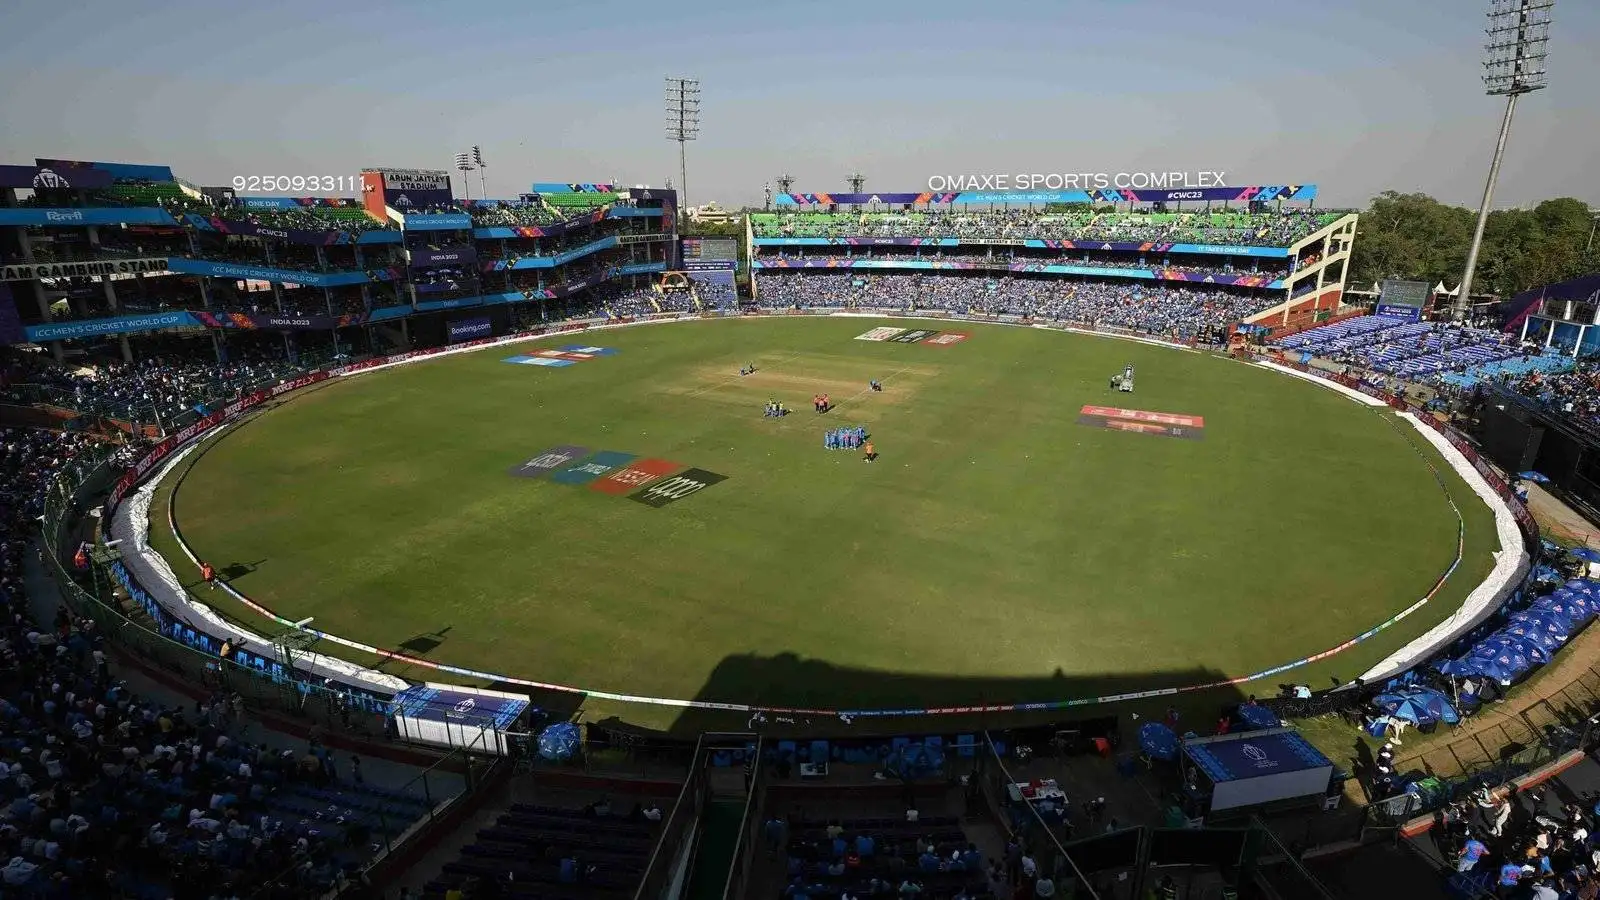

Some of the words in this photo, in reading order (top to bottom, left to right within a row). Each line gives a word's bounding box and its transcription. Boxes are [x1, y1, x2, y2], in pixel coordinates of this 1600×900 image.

[400, 182, 437, 190] STADIUM
[1167, 191, 1203, 199] #CWC23
[257, 228, 288, 238] #CWC23
[36, 262, 114, 278] GAMBHIR
[119, 259, 168, 273] STAND
[225, 268, 249, 276] MEN'S
[249, 270, 279, 278] CRICKET
[280, 272, 305, 281] WORLD
[305, 275, 320, 283] CUP
[35, 329, 55, 337] ICC
[55, 325, 83, 336] MEN'S
[85, 321, 125, 331] CRICKET
[126, 317, 160, 327] WORLD
[161, 316, 179, 325] CUP
[451, 323, 491, 334] Booking.com
[388, 353, 411, 363] MRF
[328, 364, 351, 378] MRF
[272, 381, 295, 396] MRF
[224, 401, 244, 418] MRF
[243, 394, 259, 409] ZLX
[176, 421, 198, 445] MRF
[642, 476, 706, 501] oppo
